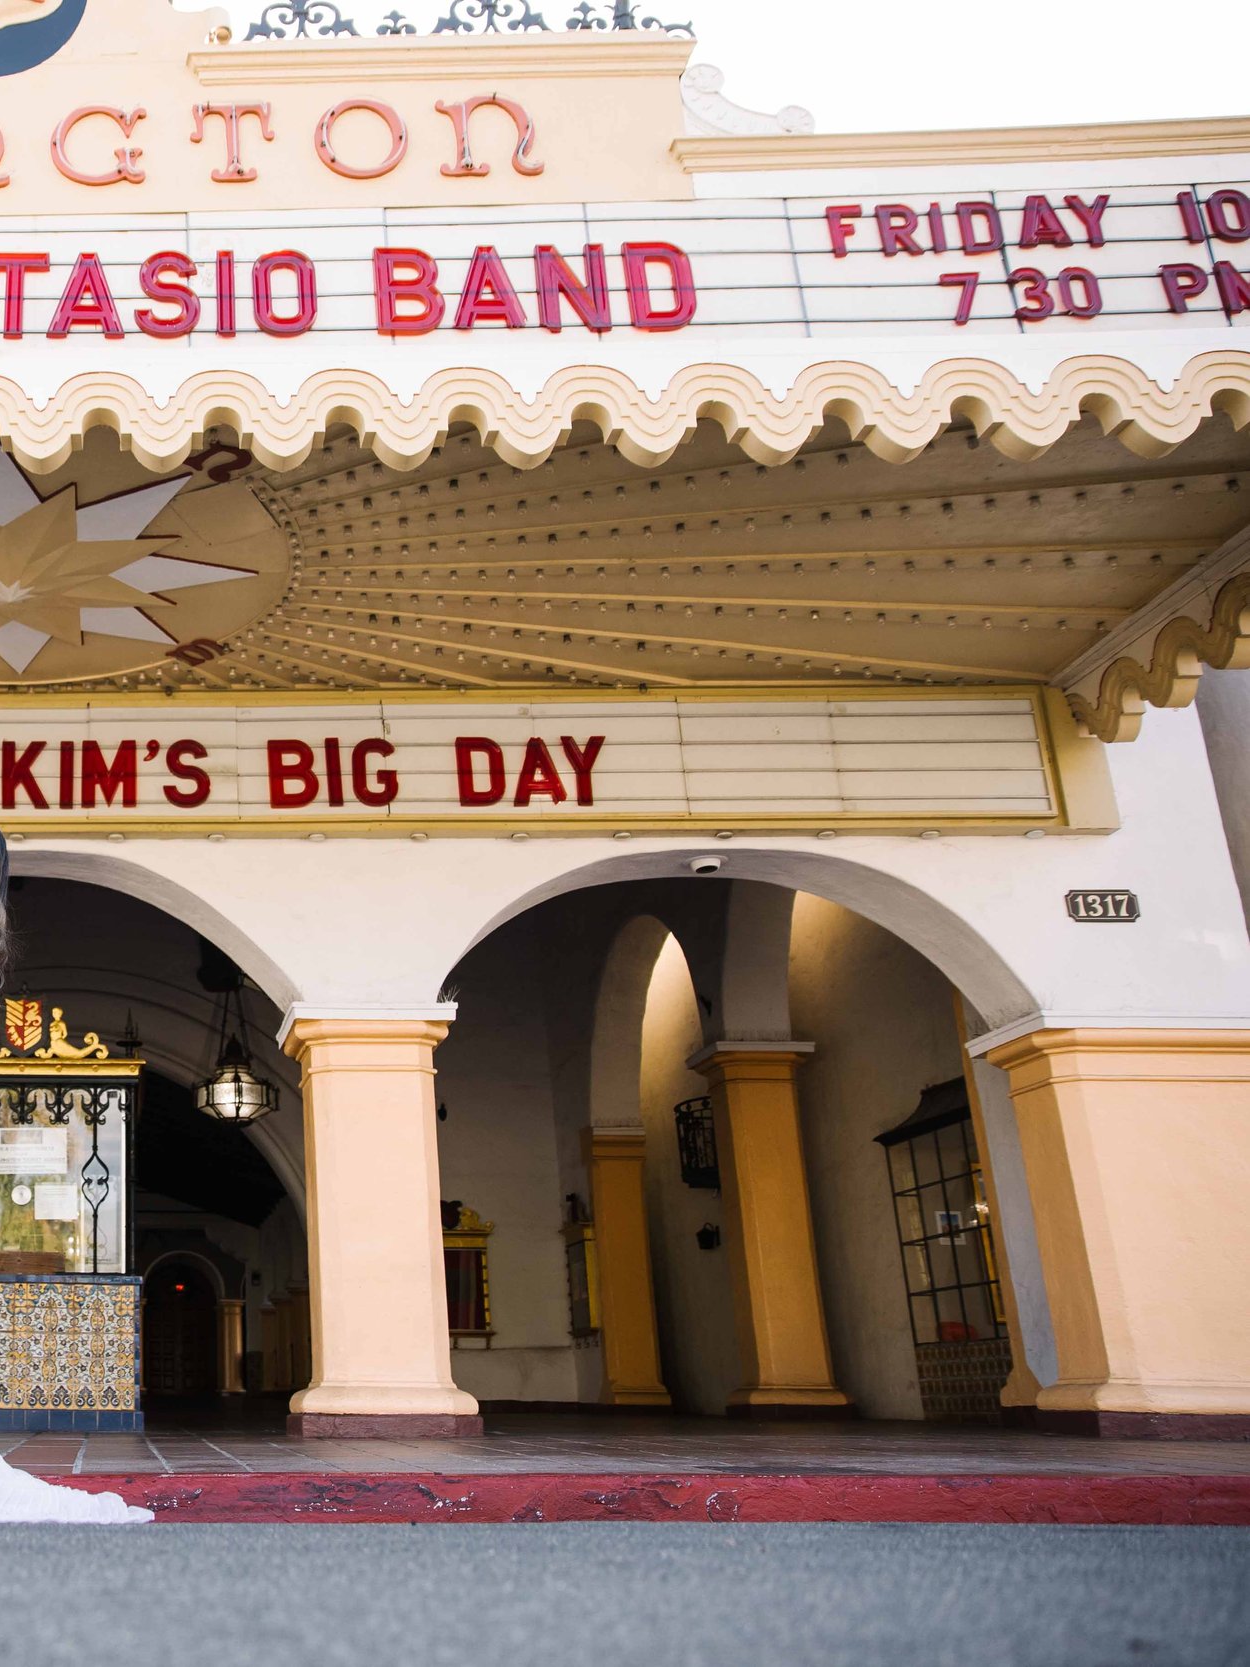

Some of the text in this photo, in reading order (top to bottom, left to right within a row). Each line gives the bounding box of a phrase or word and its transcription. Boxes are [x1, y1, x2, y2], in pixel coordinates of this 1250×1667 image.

[825, 194, 1111, 258] FRIDAY
[372, 241, 698, 337] BAND
[0, 738, 212, 811] KIM'S
[266, 737, 400, 810] BIG
[454, 735, 606, 808] DAY
[1074, 894, 1130, 917] 1317
